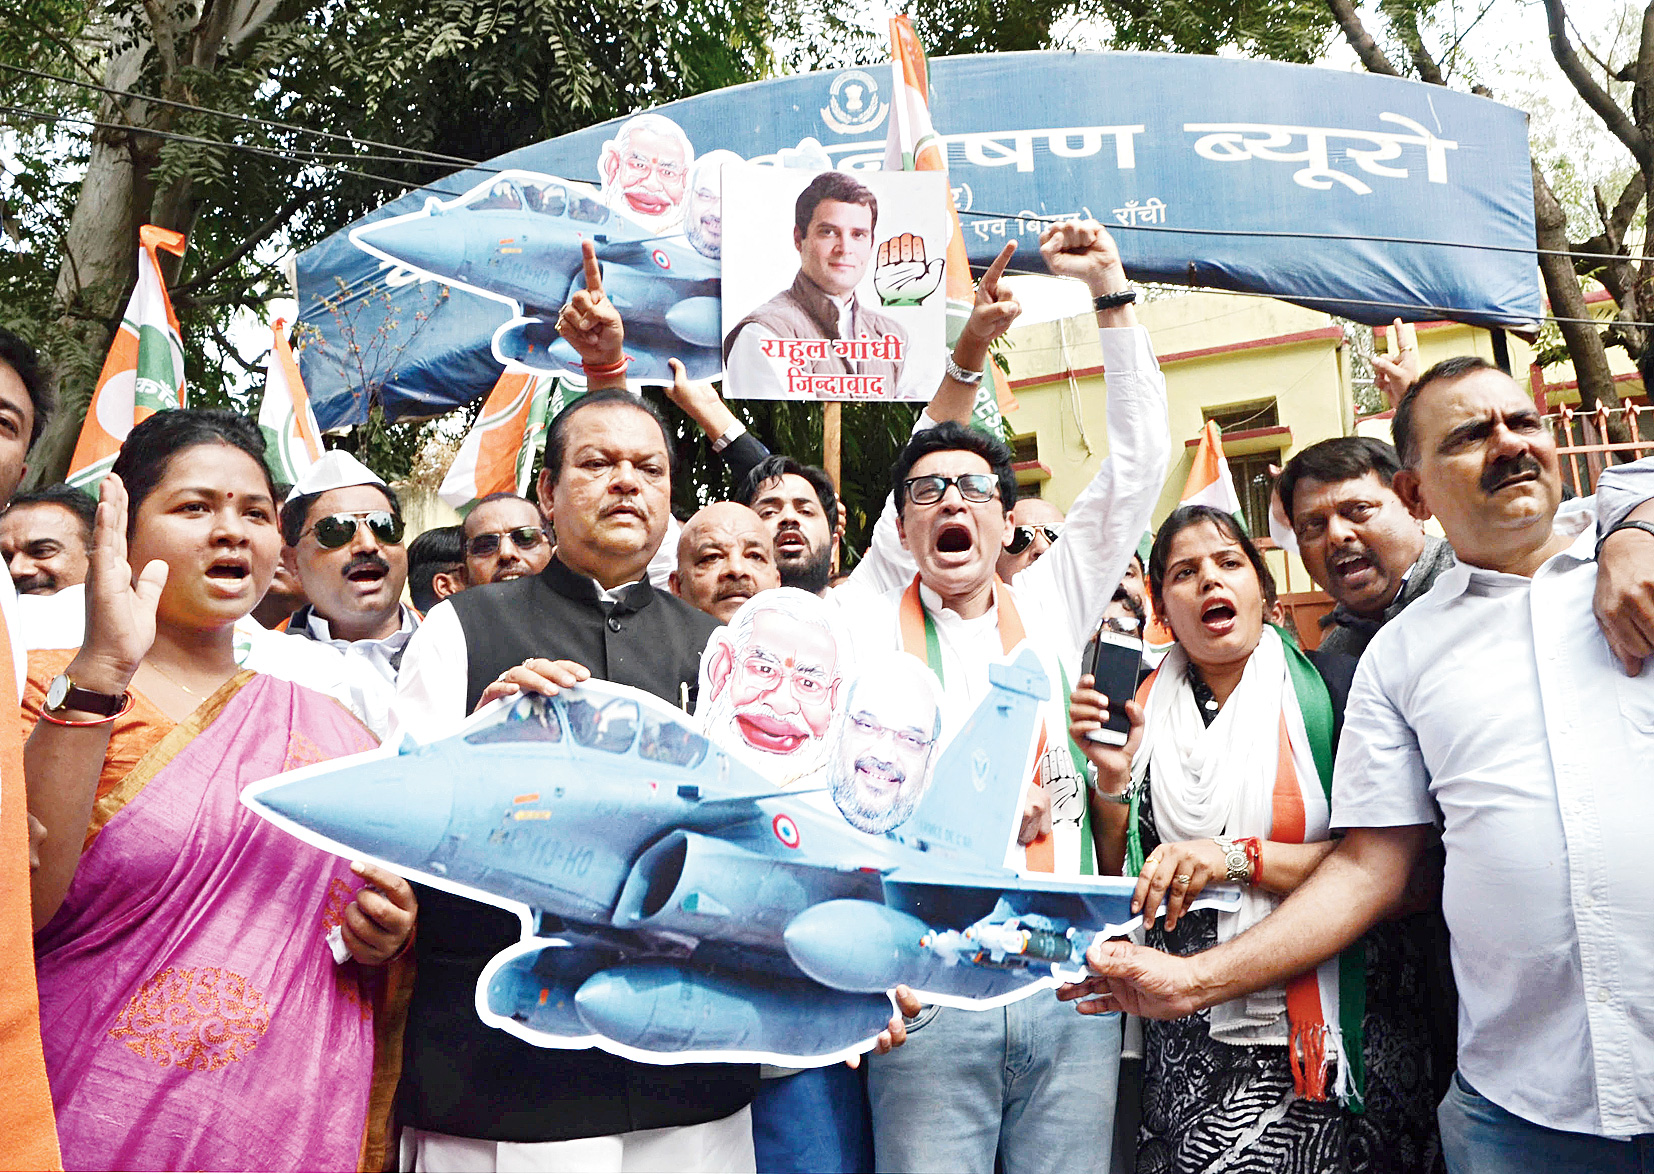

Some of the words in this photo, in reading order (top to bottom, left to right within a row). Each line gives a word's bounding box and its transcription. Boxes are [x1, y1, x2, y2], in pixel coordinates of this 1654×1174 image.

[1184, 111, 1459, 195] ब्यूरो
[1112, 197, 1168, 227] राँची
[760, 338, 829, 366] राहुल
[834, 334, 904, 360] गांधी
